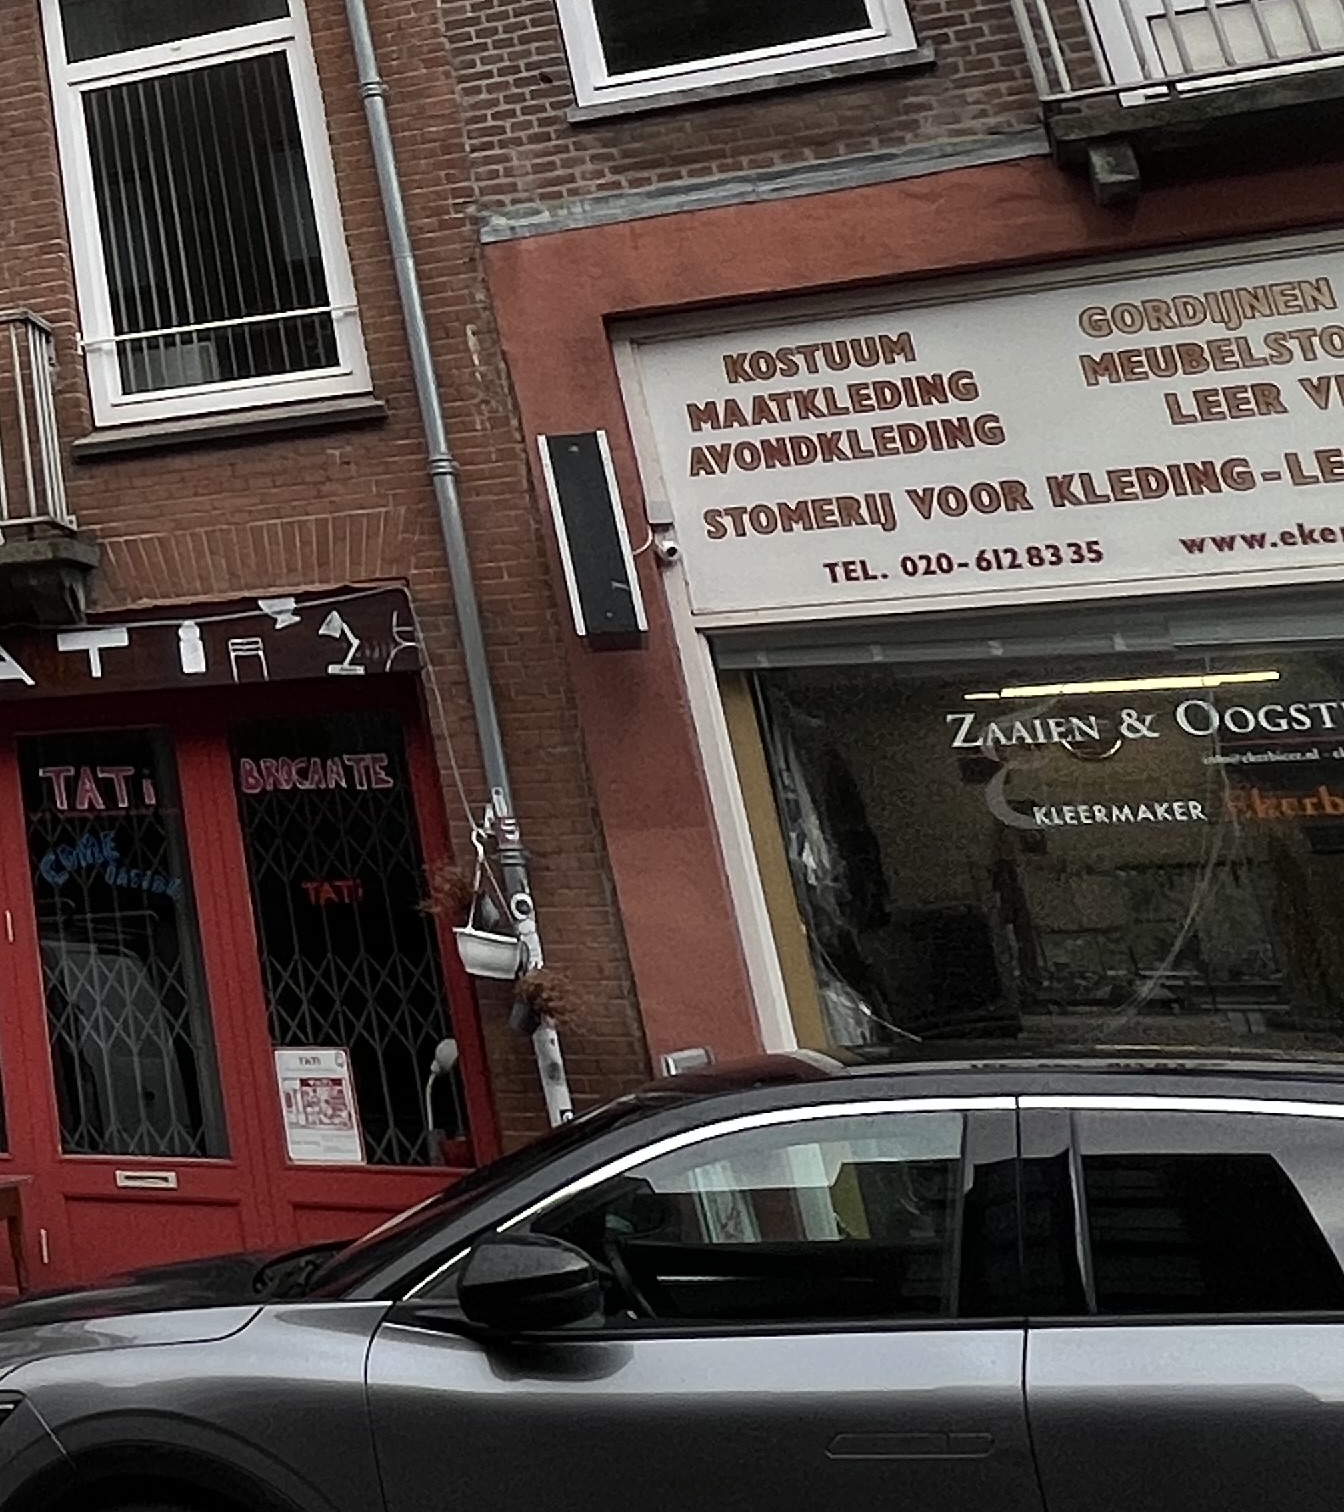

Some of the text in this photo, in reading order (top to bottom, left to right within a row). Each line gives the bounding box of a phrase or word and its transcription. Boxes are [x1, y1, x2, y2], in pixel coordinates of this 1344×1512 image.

[1078, 277, 1338, 338] GORDIJNEN
[722, 332, 917, 384] KOSTUUM
[686, 370, 981, 432] MAATKLEDING
[1164, 382, 1289, 426] LEER
[689, 414, 1007, 477] AVONDKLEDING
[703, 491, 898, 541] STOMERIJ
[906, 479, 1034, 521] VOOR
[823, 560, 890, 584] TEL.
[1120, 708, 1161, 738] &
[239, 753, 394, 794] BROCANTE
[1032, 800, 1208, 827] KLEERMAKER
